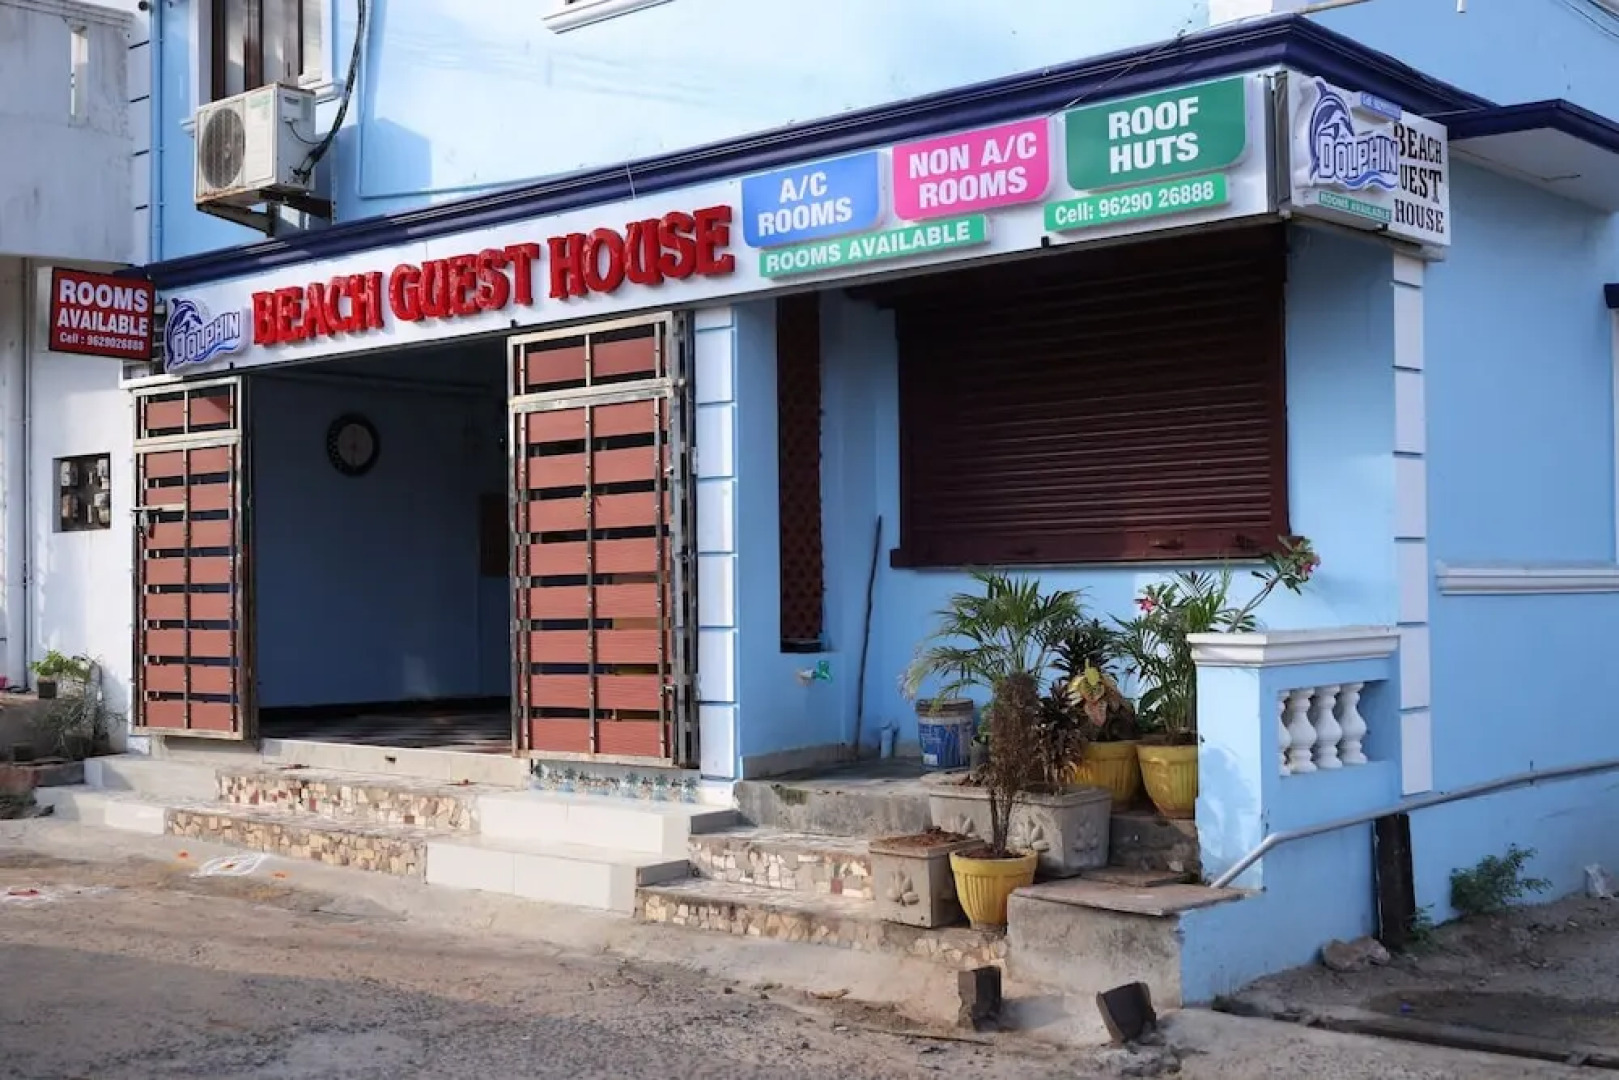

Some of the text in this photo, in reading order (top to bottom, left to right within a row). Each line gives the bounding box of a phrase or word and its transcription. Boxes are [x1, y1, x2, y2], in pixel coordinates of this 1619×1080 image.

[1108, 96, 1199, 140] ROOF
[909, 132, 1037, 179] NON A/C
[1109, 132, 1199, 174] HUTS
[1317, 134, 1399, 180] DOLPHIN
[1393, 122, 1442, 165] BEACH
[779, 171, 828, 203] A/C
[919, 166, 1028, 209] ROOMS
[1054, 180, 1215, 226] Cell: 96290 26888
[1399, 163, 1442, 204] UEST
[758, 197, 853, 237] ROOMS
[1393, 198, 1444, 234] HOUSE
[766, 220, 971, 273] ROOMS AVAILABLE
[60, 278, 148, 313] ROOMS
[252, 204, 736, 346] BEACH GUEST HOUSE
[57, 307, 148, 337] AVAILABLE
[173, 310, 240, 366] DOLPHIN
